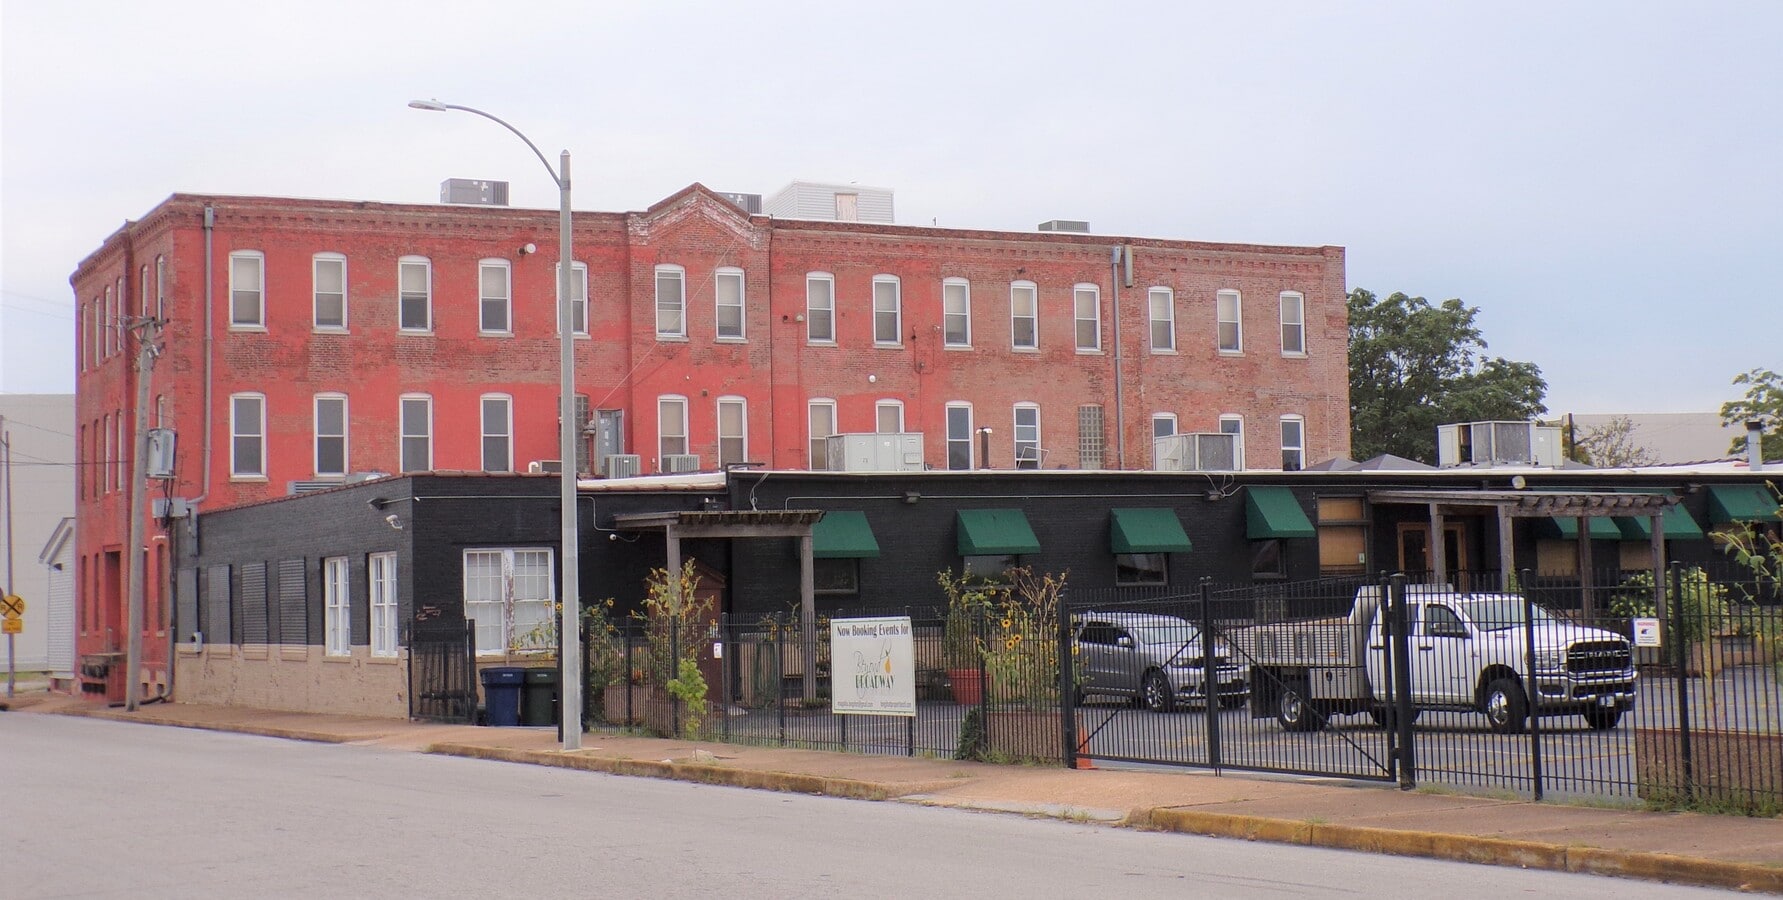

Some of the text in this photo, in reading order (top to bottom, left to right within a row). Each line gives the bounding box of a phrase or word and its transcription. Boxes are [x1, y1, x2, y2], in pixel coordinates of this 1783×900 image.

[837, 623, 909, 638] Now Booking Events for
[855, 675, 894, 689] BROADWAY
